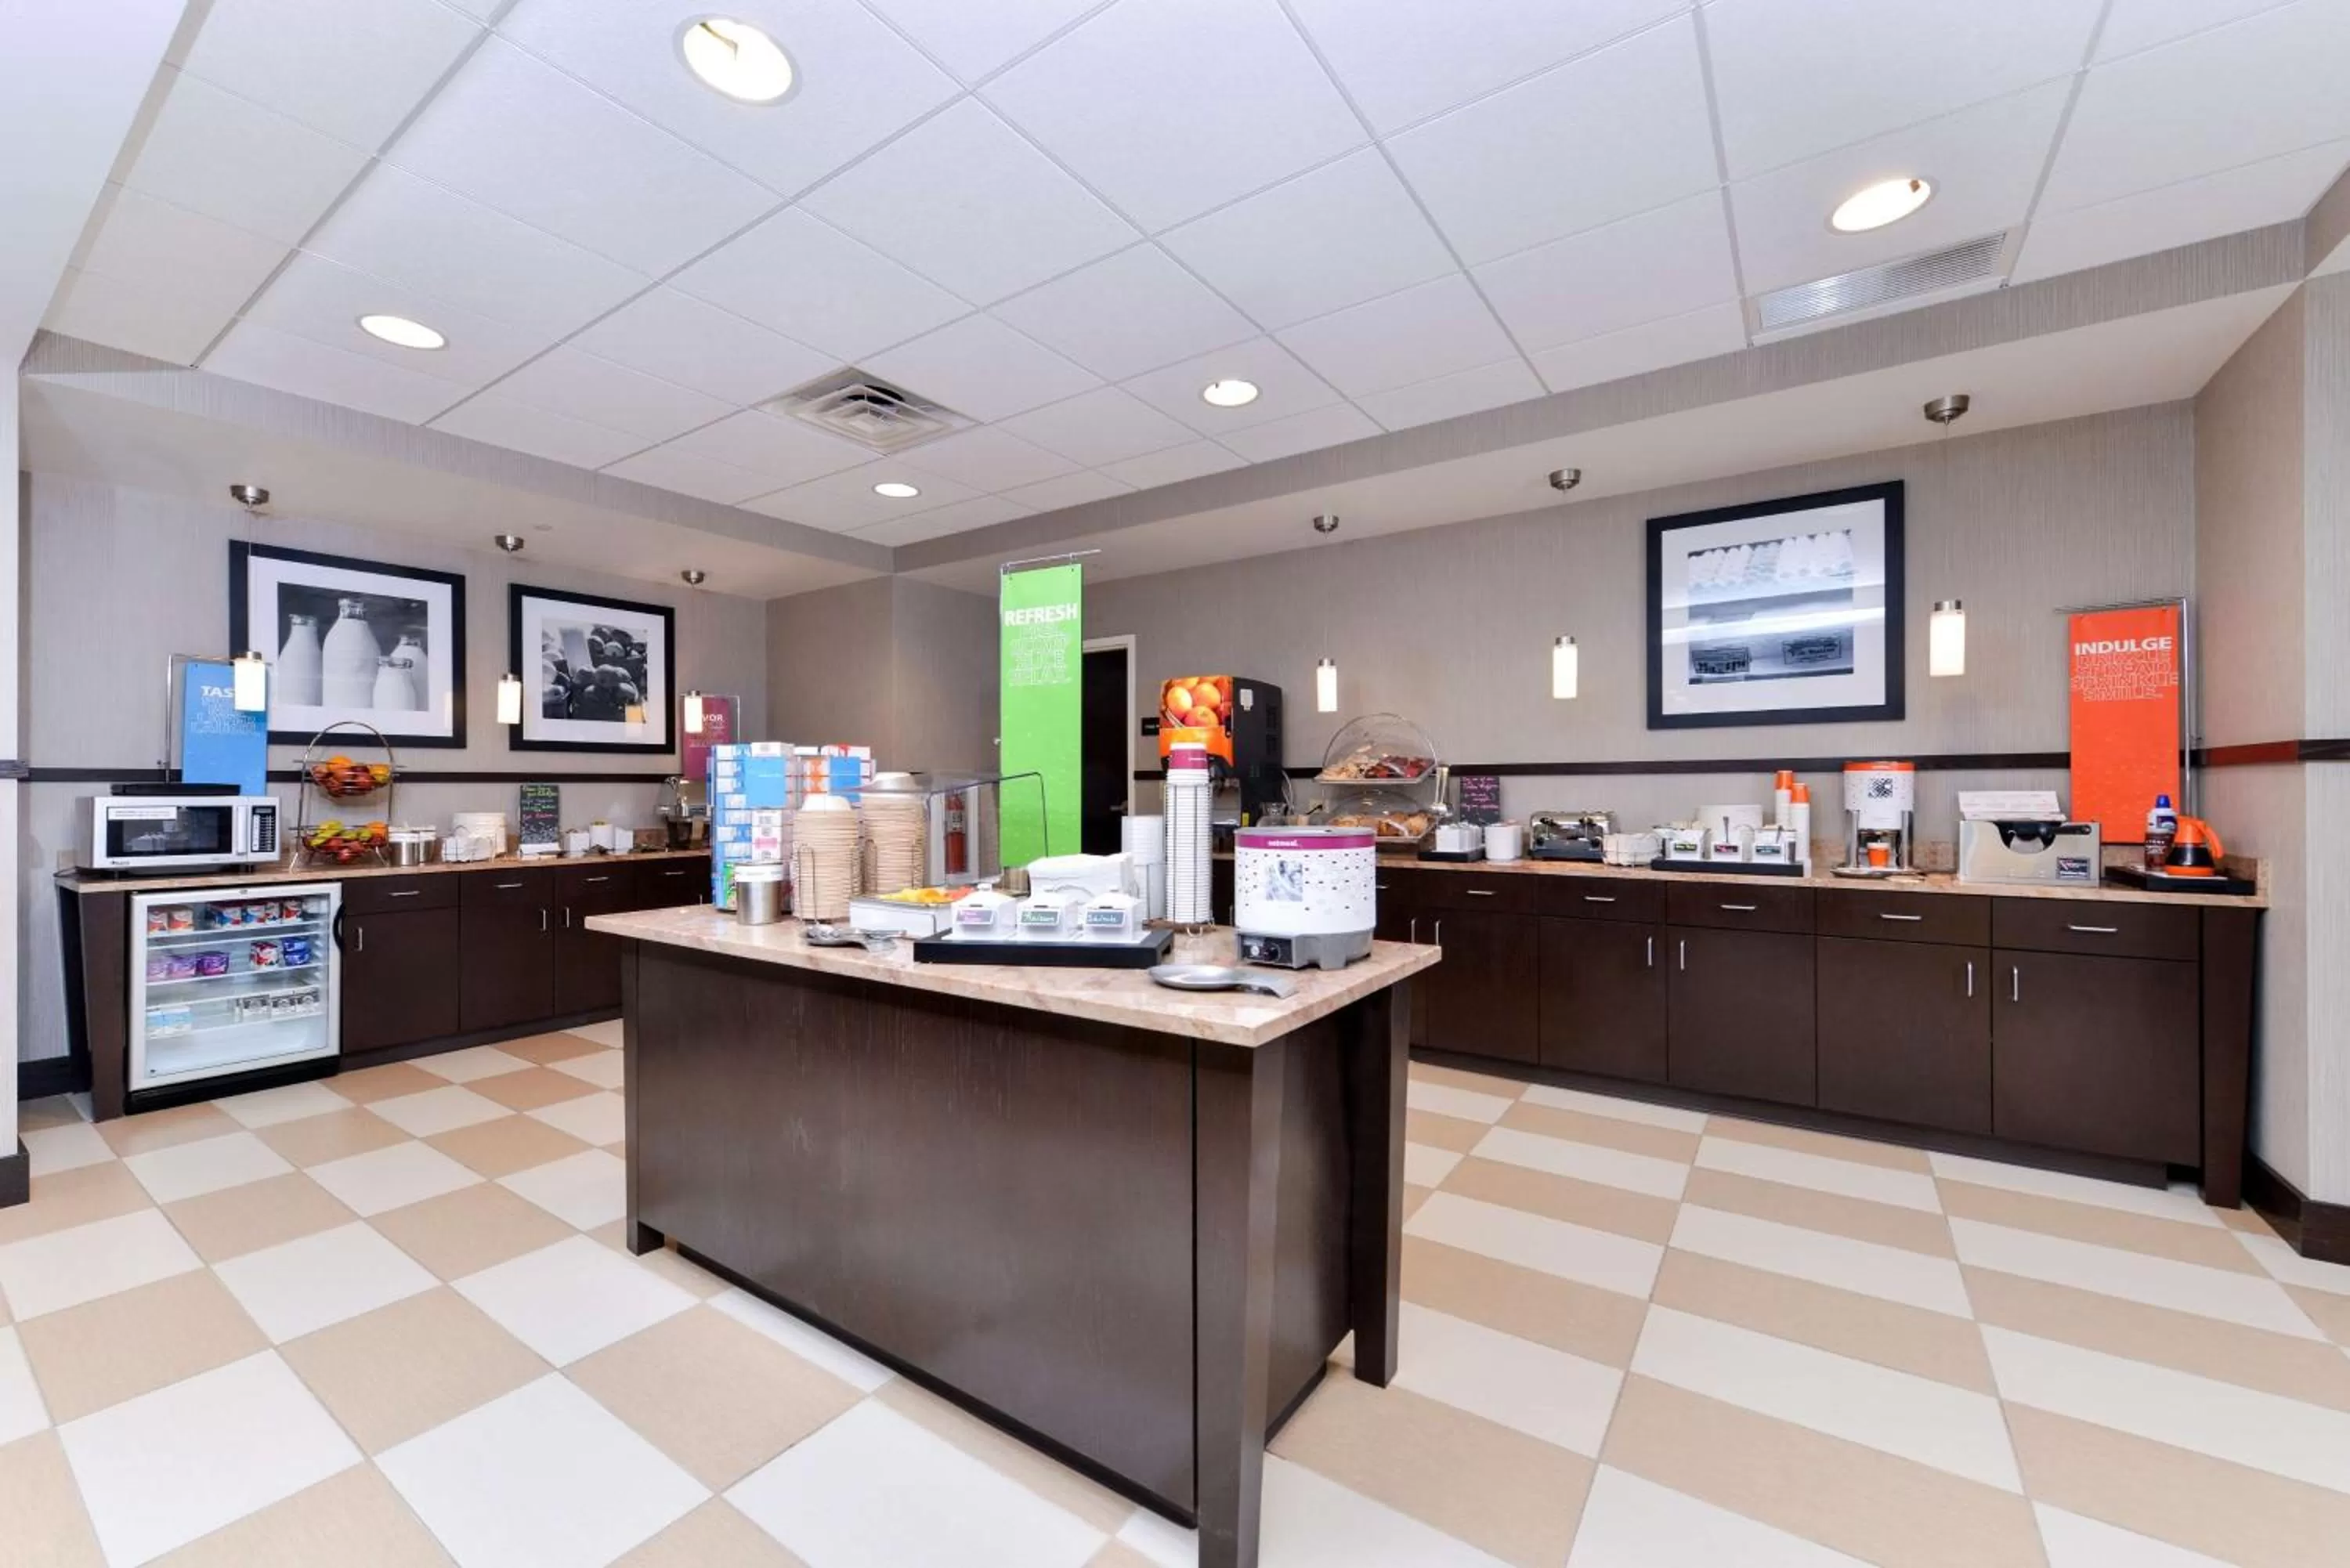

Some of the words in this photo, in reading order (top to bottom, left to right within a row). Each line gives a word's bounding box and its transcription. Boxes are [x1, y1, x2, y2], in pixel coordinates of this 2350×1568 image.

[1004, 602, 1079, 627] REFRESH
[2074, 635, 2173, 656] INDULGE
[200, 685, 235, 698] TAS
[702, 714, 723, 722] VOR
